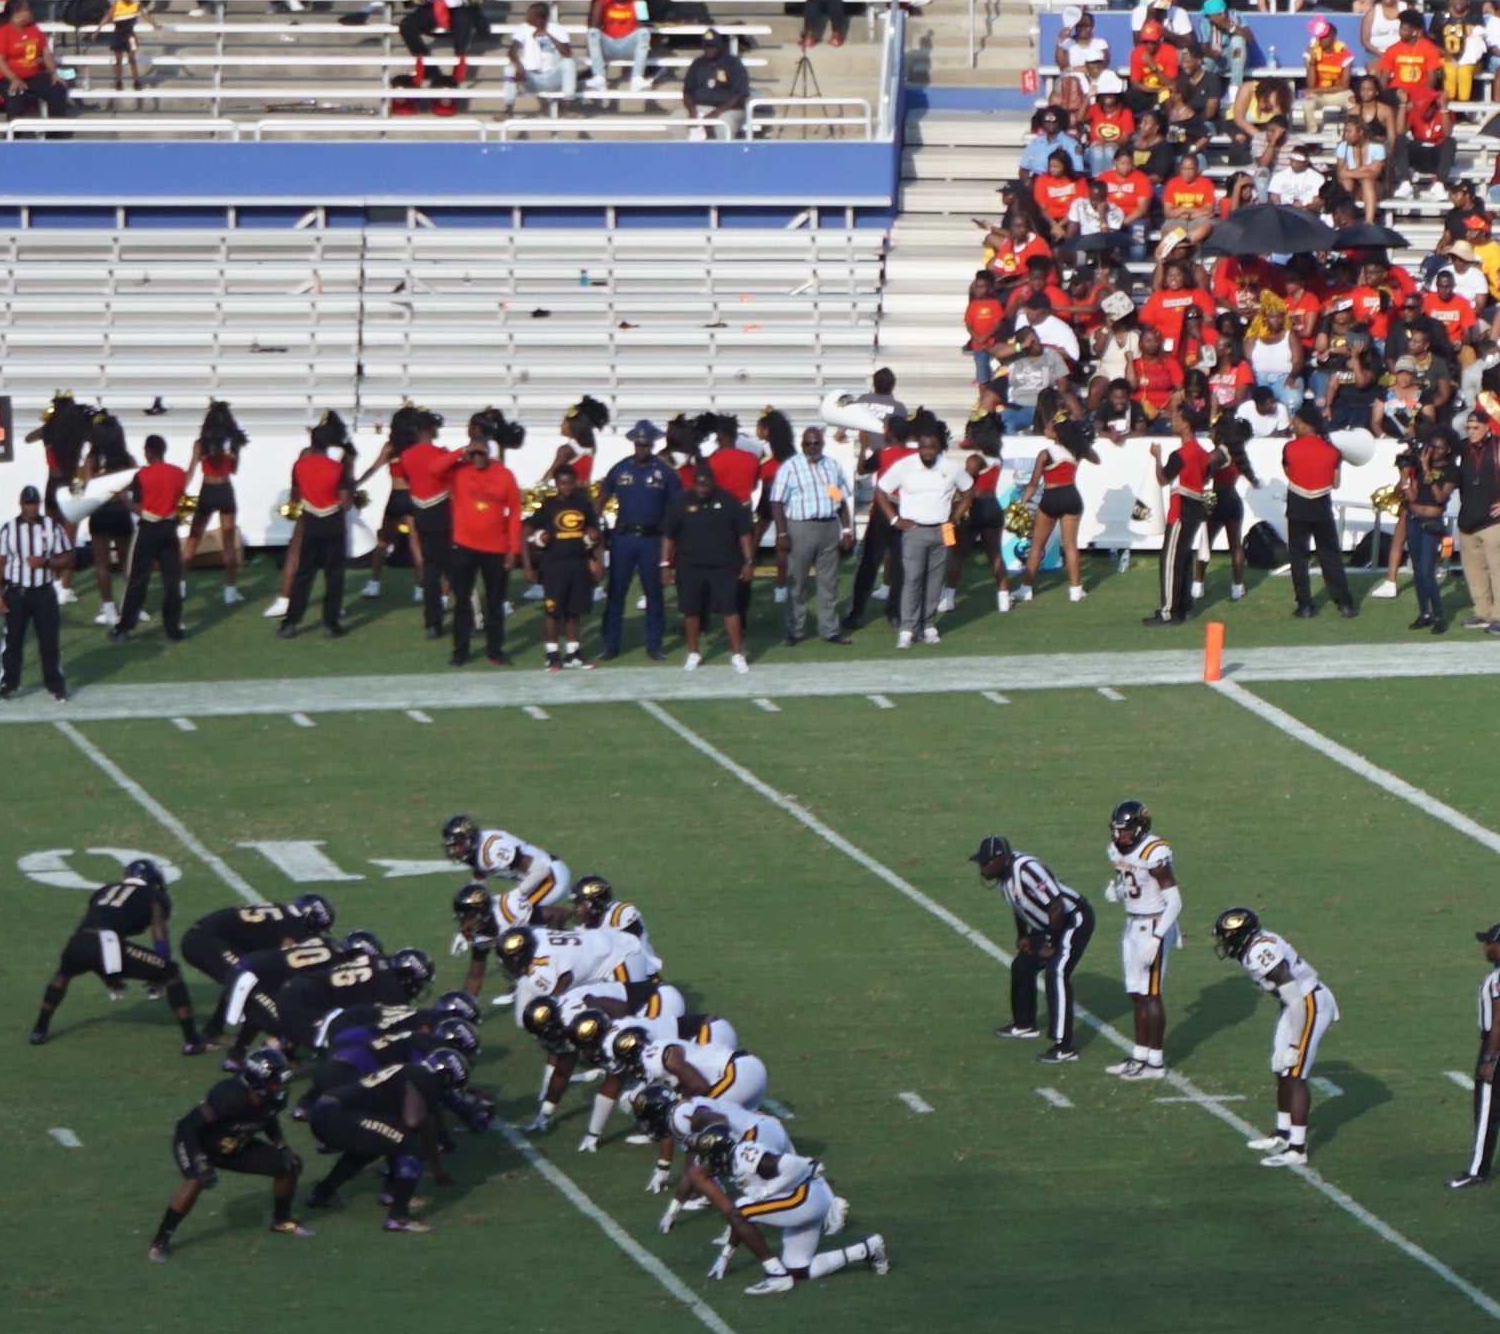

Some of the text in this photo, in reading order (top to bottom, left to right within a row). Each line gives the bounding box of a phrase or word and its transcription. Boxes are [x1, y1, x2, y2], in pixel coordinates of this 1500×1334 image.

[95, 884, 136, 908] 11
[1257, 948, 1276, 968] 28
[360, 1119, 404, 1144] PANTHERS
